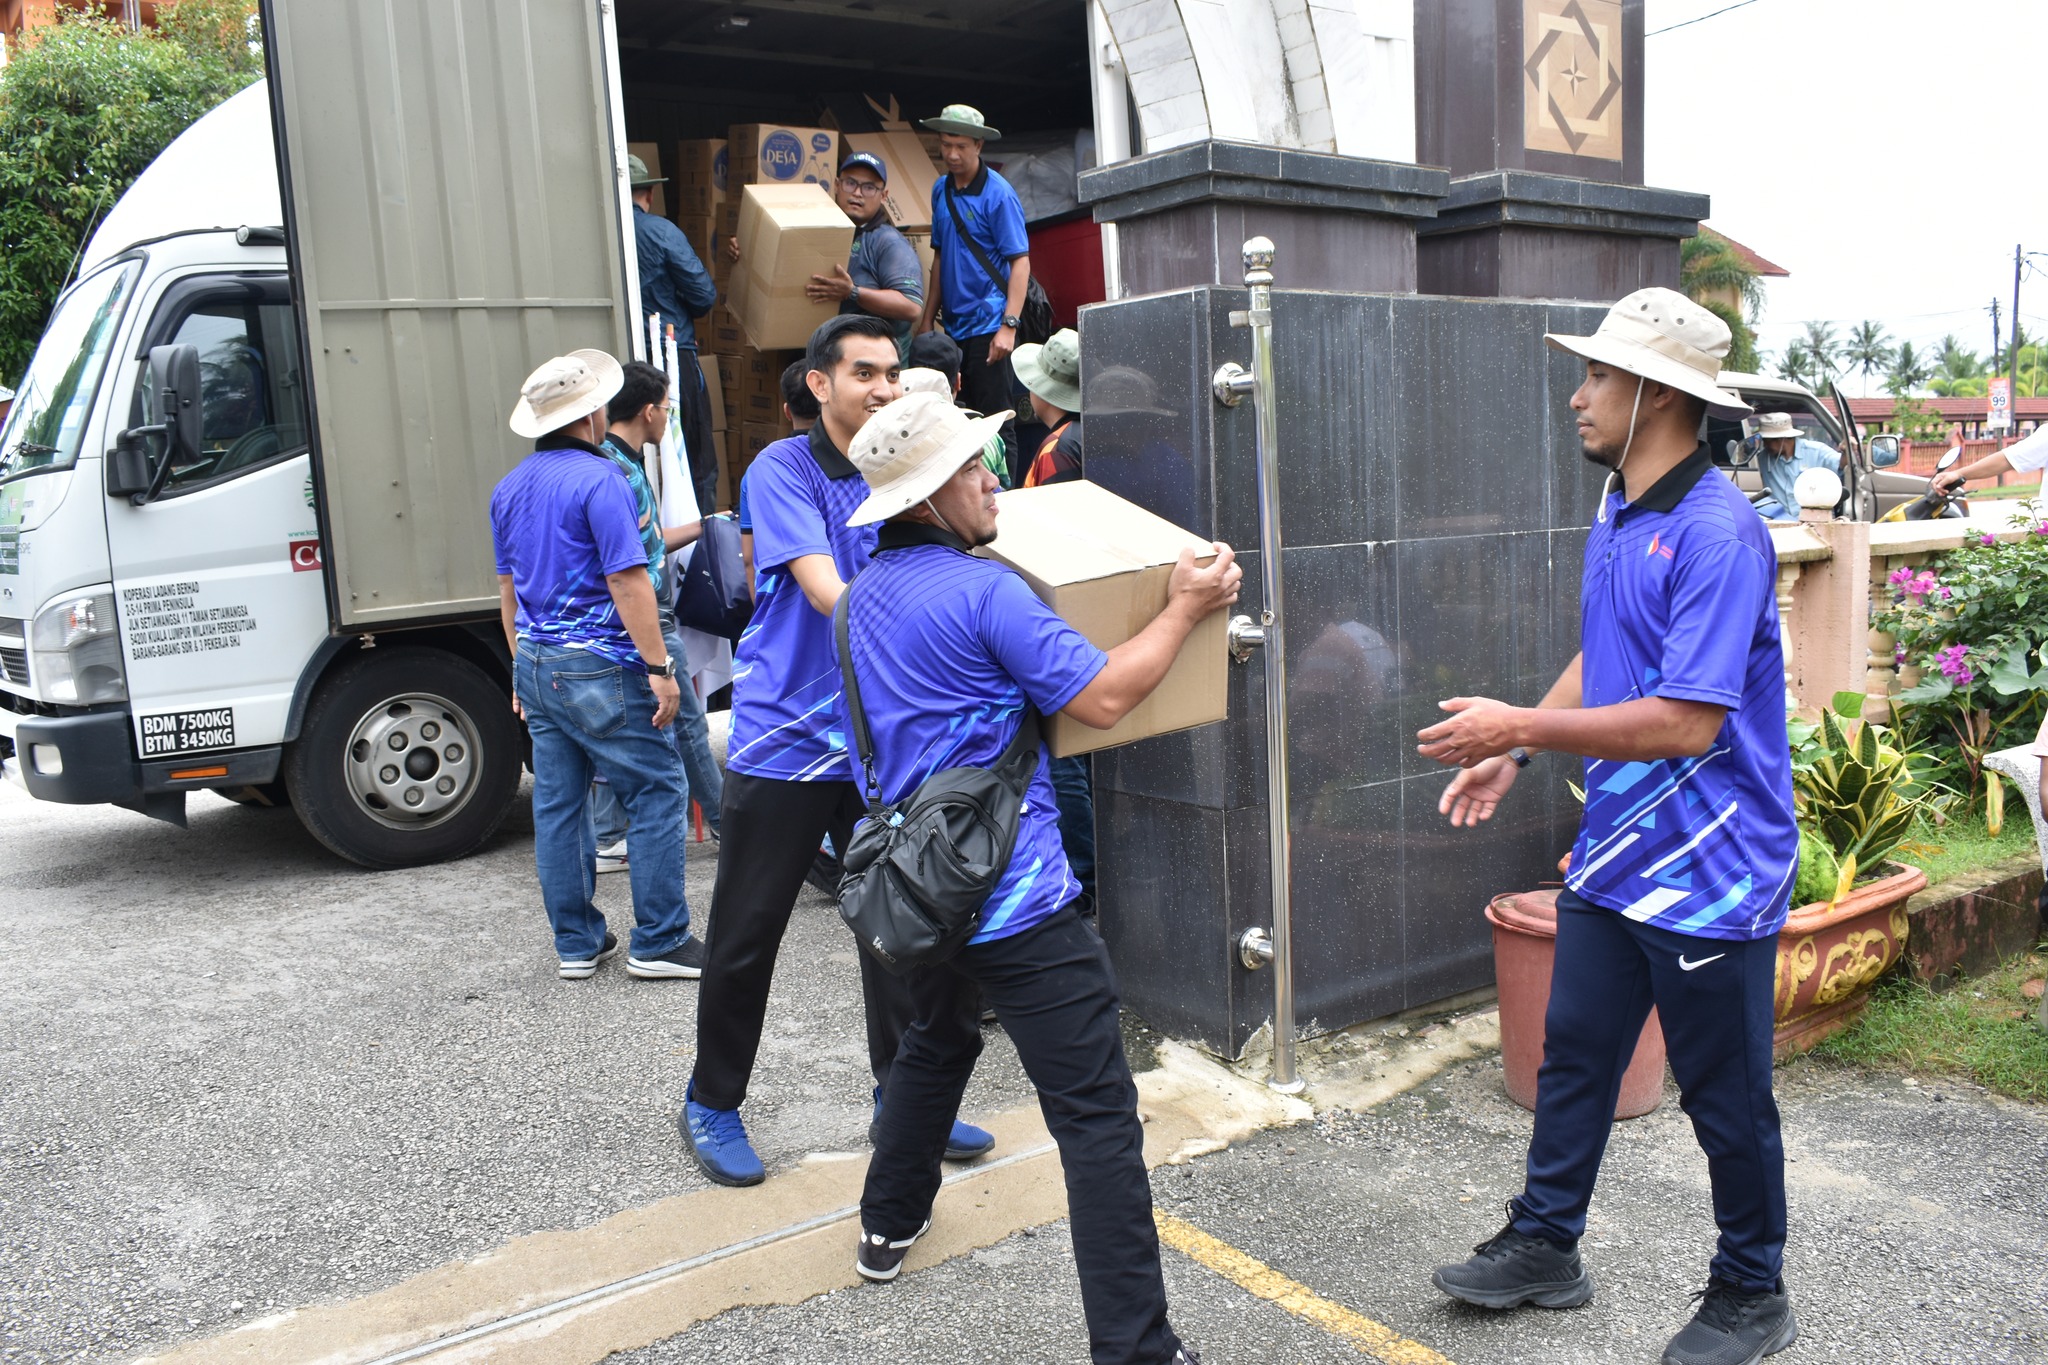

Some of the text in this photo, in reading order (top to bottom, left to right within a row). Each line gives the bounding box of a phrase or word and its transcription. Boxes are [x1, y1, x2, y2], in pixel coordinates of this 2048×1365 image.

[766, 149, 797, 165] DESA
[1992, 396, 2006, 406] 99
[123, 581, 199, 601] KOPERASI LADANG BERHAD
[125, 596, 194, 616] 2-5-14 PRIMA PENINSULA
[128, 605, 249, 631] JLN SETIAWANGSA 11 TAMAN SETIAWANGSA
[130, 618, 257, 646] 54200 KUALA LUMPUR WILAYAH PERSEKUTUAN
[132, 642, 181, 660] BARANG-BARANG
[194, 640, 199, 652] &
[204, 636, 229, 650] PEKERJA
[143, 710, 232, 734] BDM 7500KG
[145, 728, 233, 753] BTM 3450KG
